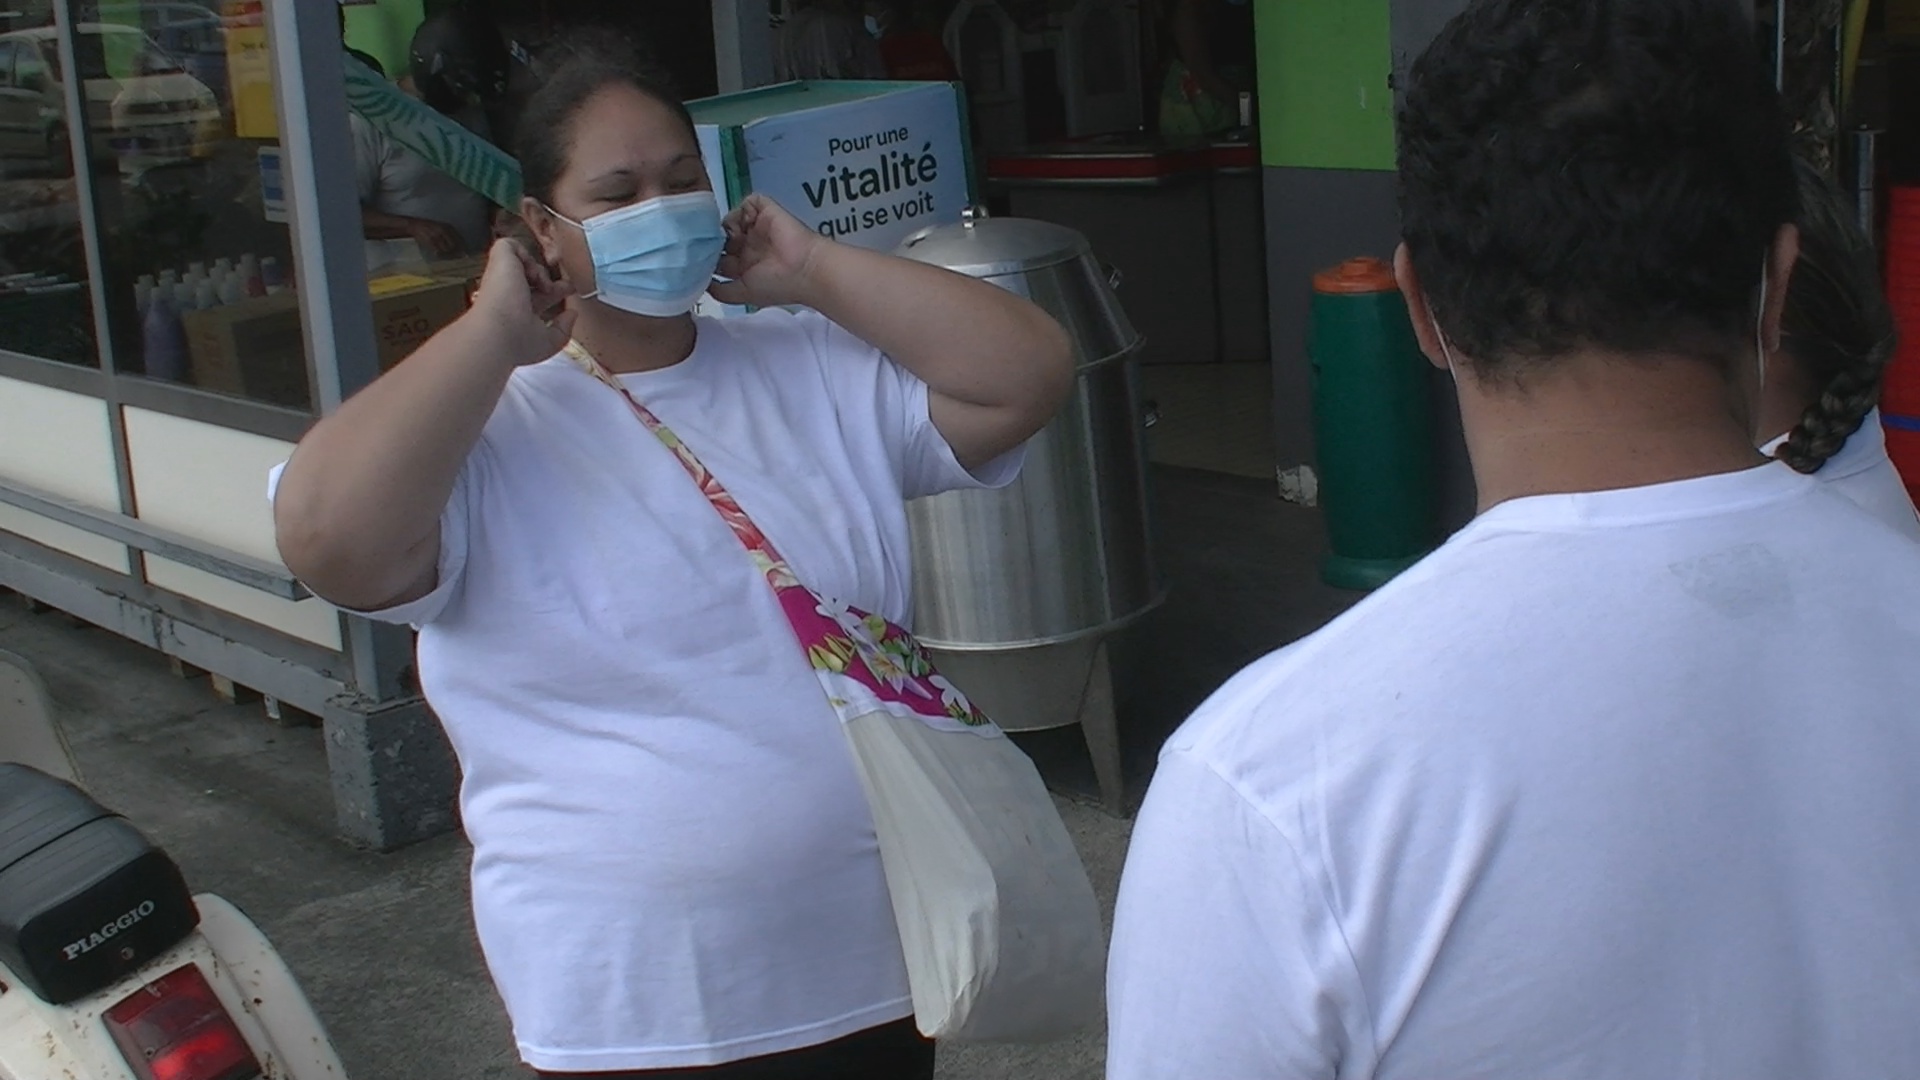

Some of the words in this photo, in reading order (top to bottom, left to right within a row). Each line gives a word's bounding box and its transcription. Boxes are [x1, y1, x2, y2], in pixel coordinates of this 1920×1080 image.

[828, 134, 873, 157] Pour
[876, 127, 909, 146] une
[802, 141, 938, 208] vitalité
[818, 207, 858, 241] qui
[862, 208, 889, 229] se
[892, 190, 934, 221] voit
[381, 318, 430, 340] SAO
[62, 900, 155, 960] PIAGGIO
